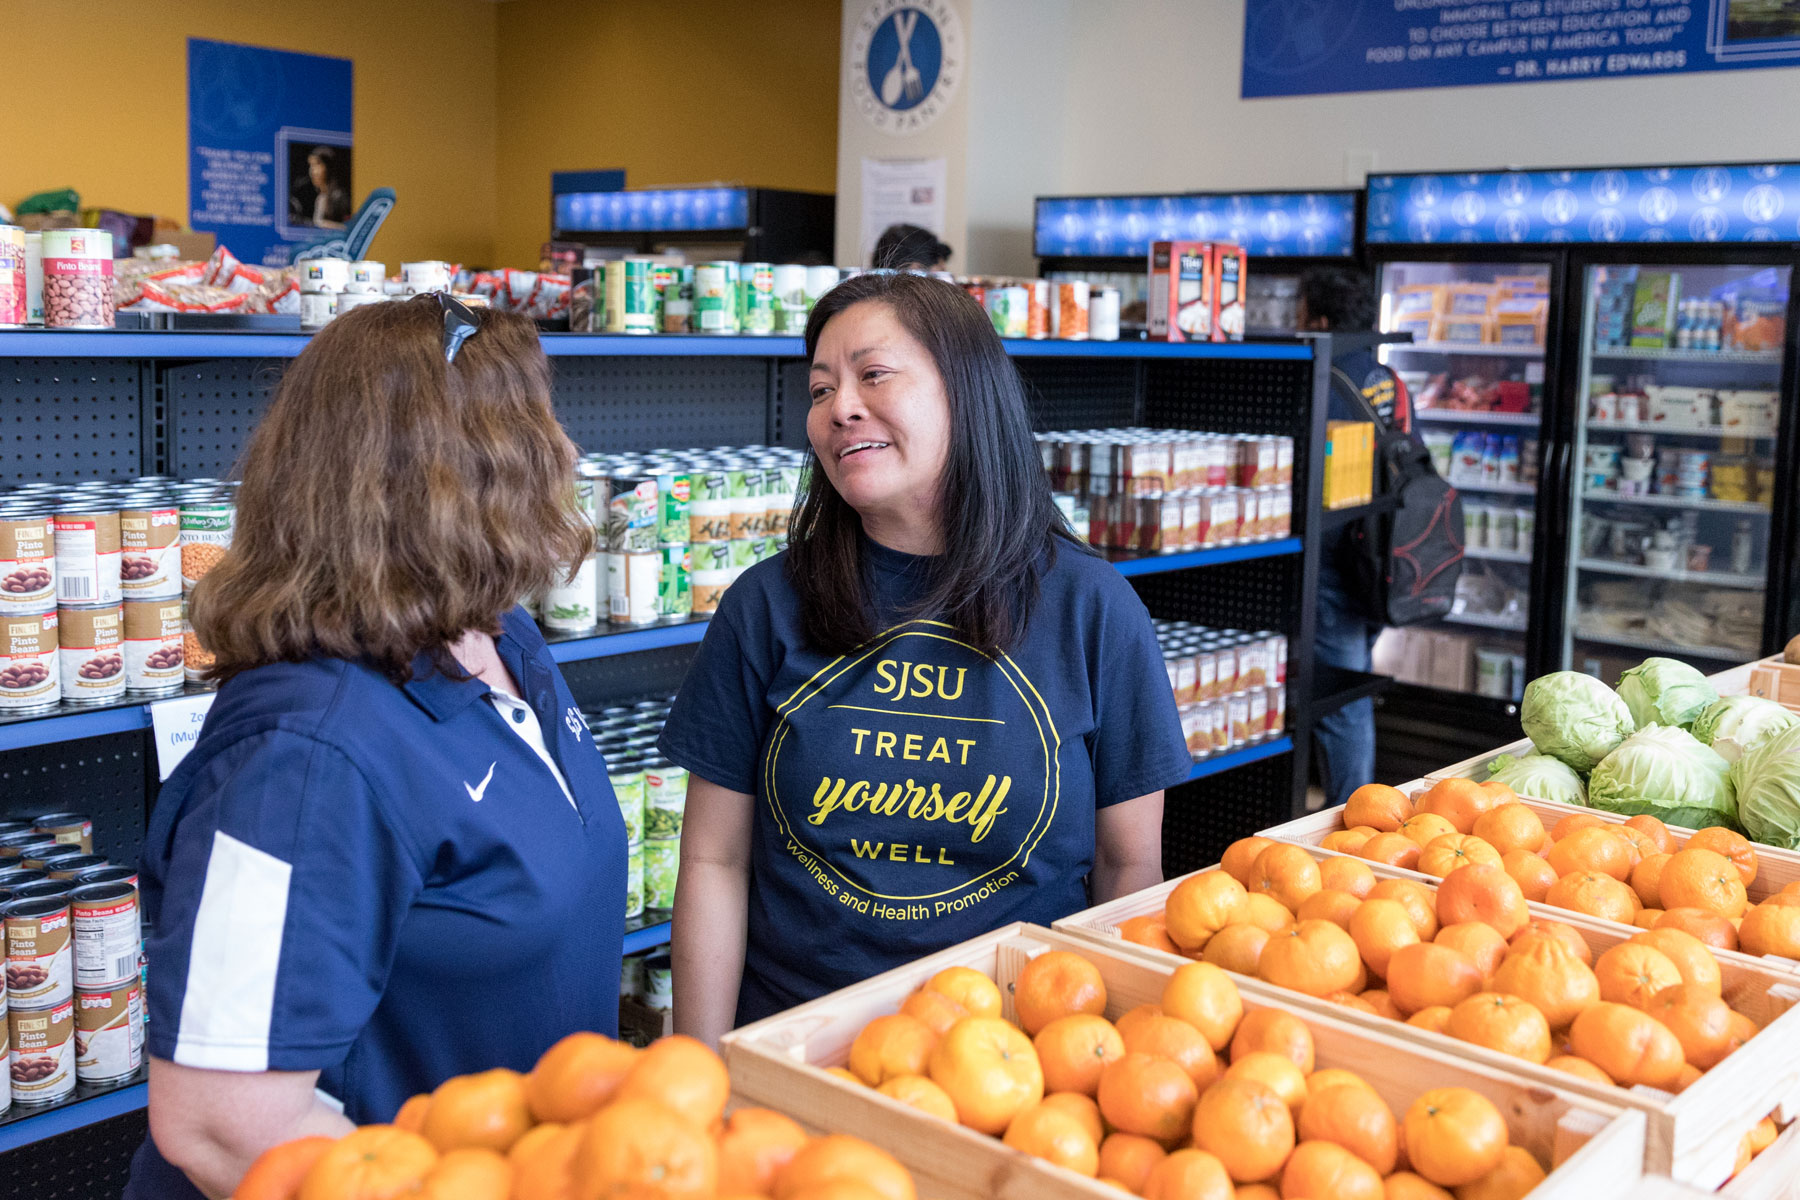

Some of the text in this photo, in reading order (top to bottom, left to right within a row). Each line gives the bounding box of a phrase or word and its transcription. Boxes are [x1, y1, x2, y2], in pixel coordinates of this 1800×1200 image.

[1511, 1, 1542, 18] FOR
[1409, 5, 1691, 43] TO CHOOSE BETWEEN EDUCATION AND
[1366, 45, 1406, 63] FOOD
[1408, 44, 1432, 60] ON
[1434, 42, 1463, 58] ANY
[1467, 36, 1529, 56] CAMPUS
[1531, 36, 1549, 52] IN
[1552, 31, 1620, 50] AMERICA
[1515, 59, 1543, 77] DR.
[1546, 55, 1604, 75] HARRY
[1606, 49, 1687, 72] EDWARDS
[56, 261, 77, 270] Pinto
[122, 530, 147, 540] Pinto
[17, 541, 44, 550] Pinto
[121, 539, 148, 547] Beans
[16, 549, 46, 558] Beans
[95, 627, 118, 637] Pinto
[11, 637, 39, 646] Pinto
[94, 636, 119, 646] Beans
[10, 645, 40, 654] Beans
[873, 659, 968, 702] SJSU
[171, 729, 201, 746] (Mul
[851, 728, 976, 766] TREAT
[807, 774, 1012, 844] yourself
[850, 838, 955, 866] WELL
[786, 839, 1019, 921] Wellness and Health Promotion
[75, 909, 91, 917] Pinto
[92, 906, 114, 917] Beans
[10, 939, 36, 948] Pinto
[10, 947, 37, 956] Beans
[20, 1032, 46, 1041] Pinto
[19, 1040, 48, 1048] Beans
